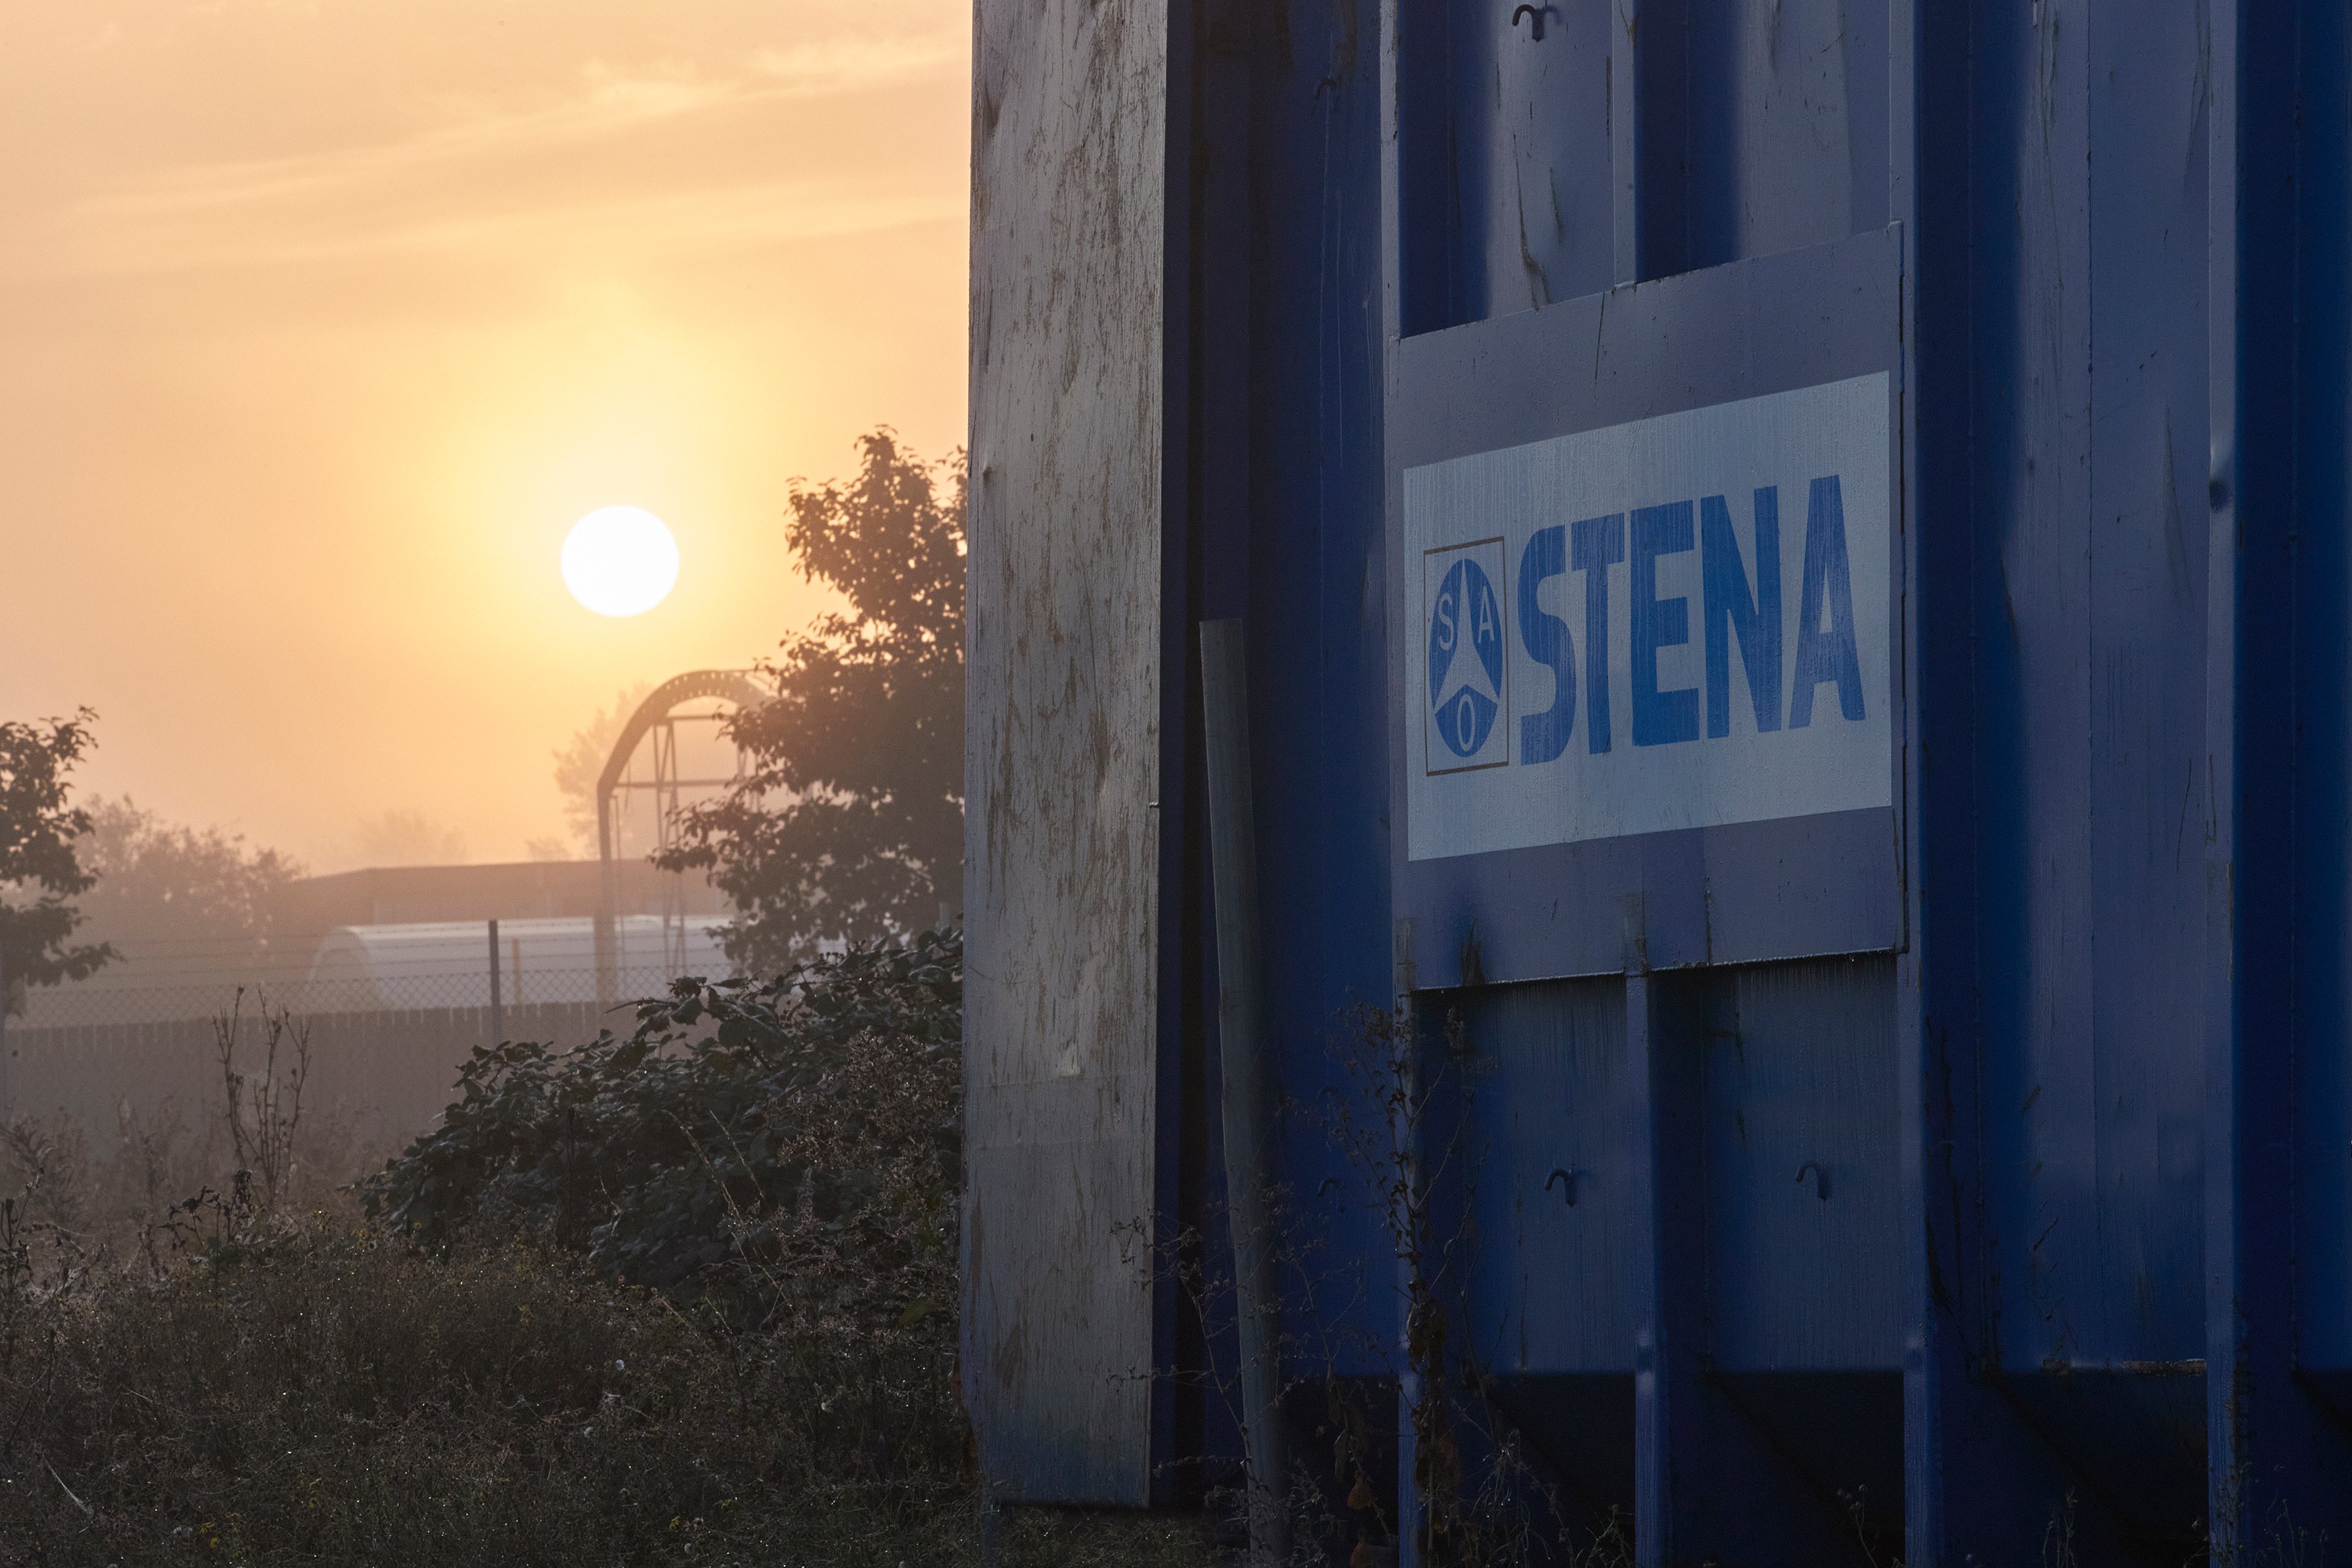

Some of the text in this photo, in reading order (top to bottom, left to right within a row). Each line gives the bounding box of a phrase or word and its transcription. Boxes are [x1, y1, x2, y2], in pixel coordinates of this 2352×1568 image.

[1438, 585, 1495, 650] S A
[1518, 475, 1866, 766] STENA
